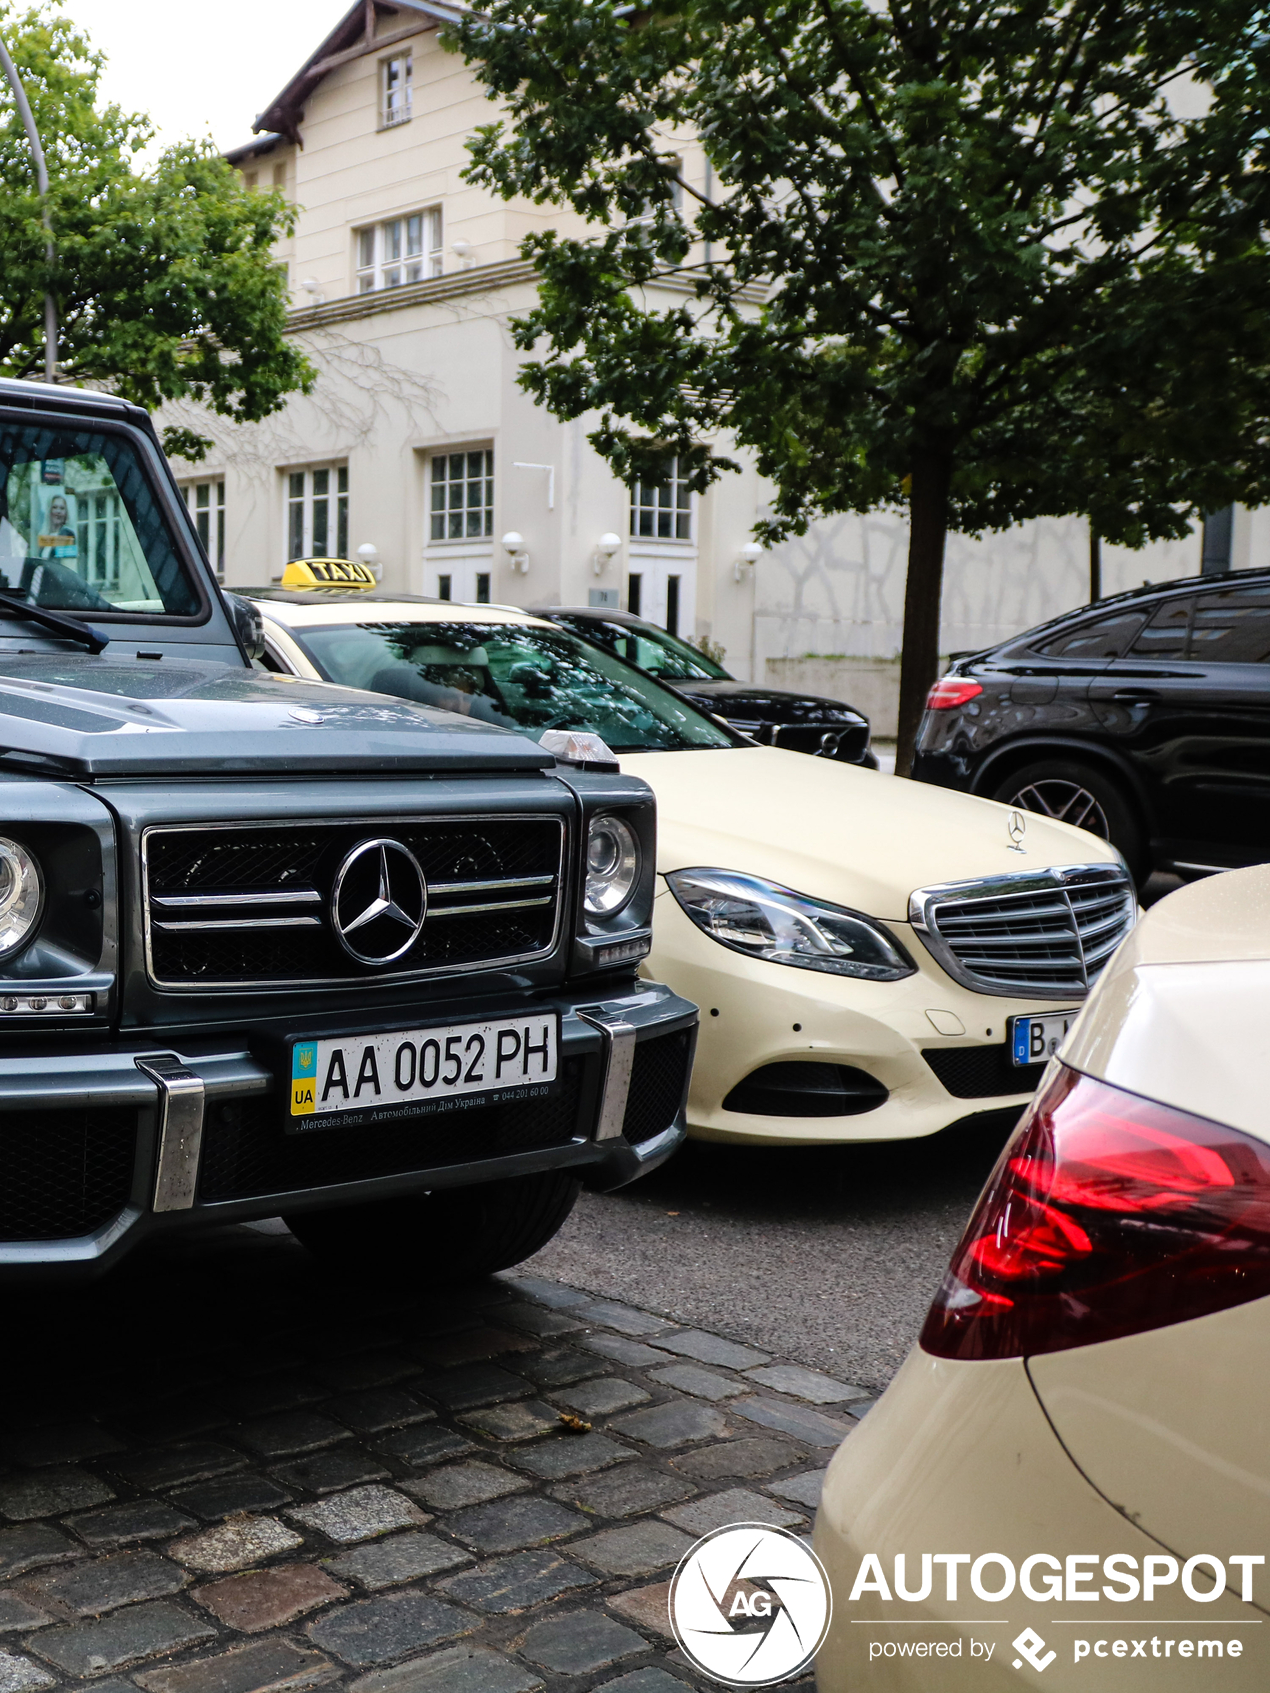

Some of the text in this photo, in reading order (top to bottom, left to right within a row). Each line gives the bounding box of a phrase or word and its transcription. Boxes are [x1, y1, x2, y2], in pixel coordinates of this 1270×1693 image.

[311, 562, 368, 582] TAXI
[321, 1024, 549, 1101] AA 0052 PH
[295, 1090, 313, 1104] UA
[300, 1114, 363, 1131] Mercedes-Benz
[455, 1097, 485, 1110] Україна
[502, 1092, 515, 1101] 044
